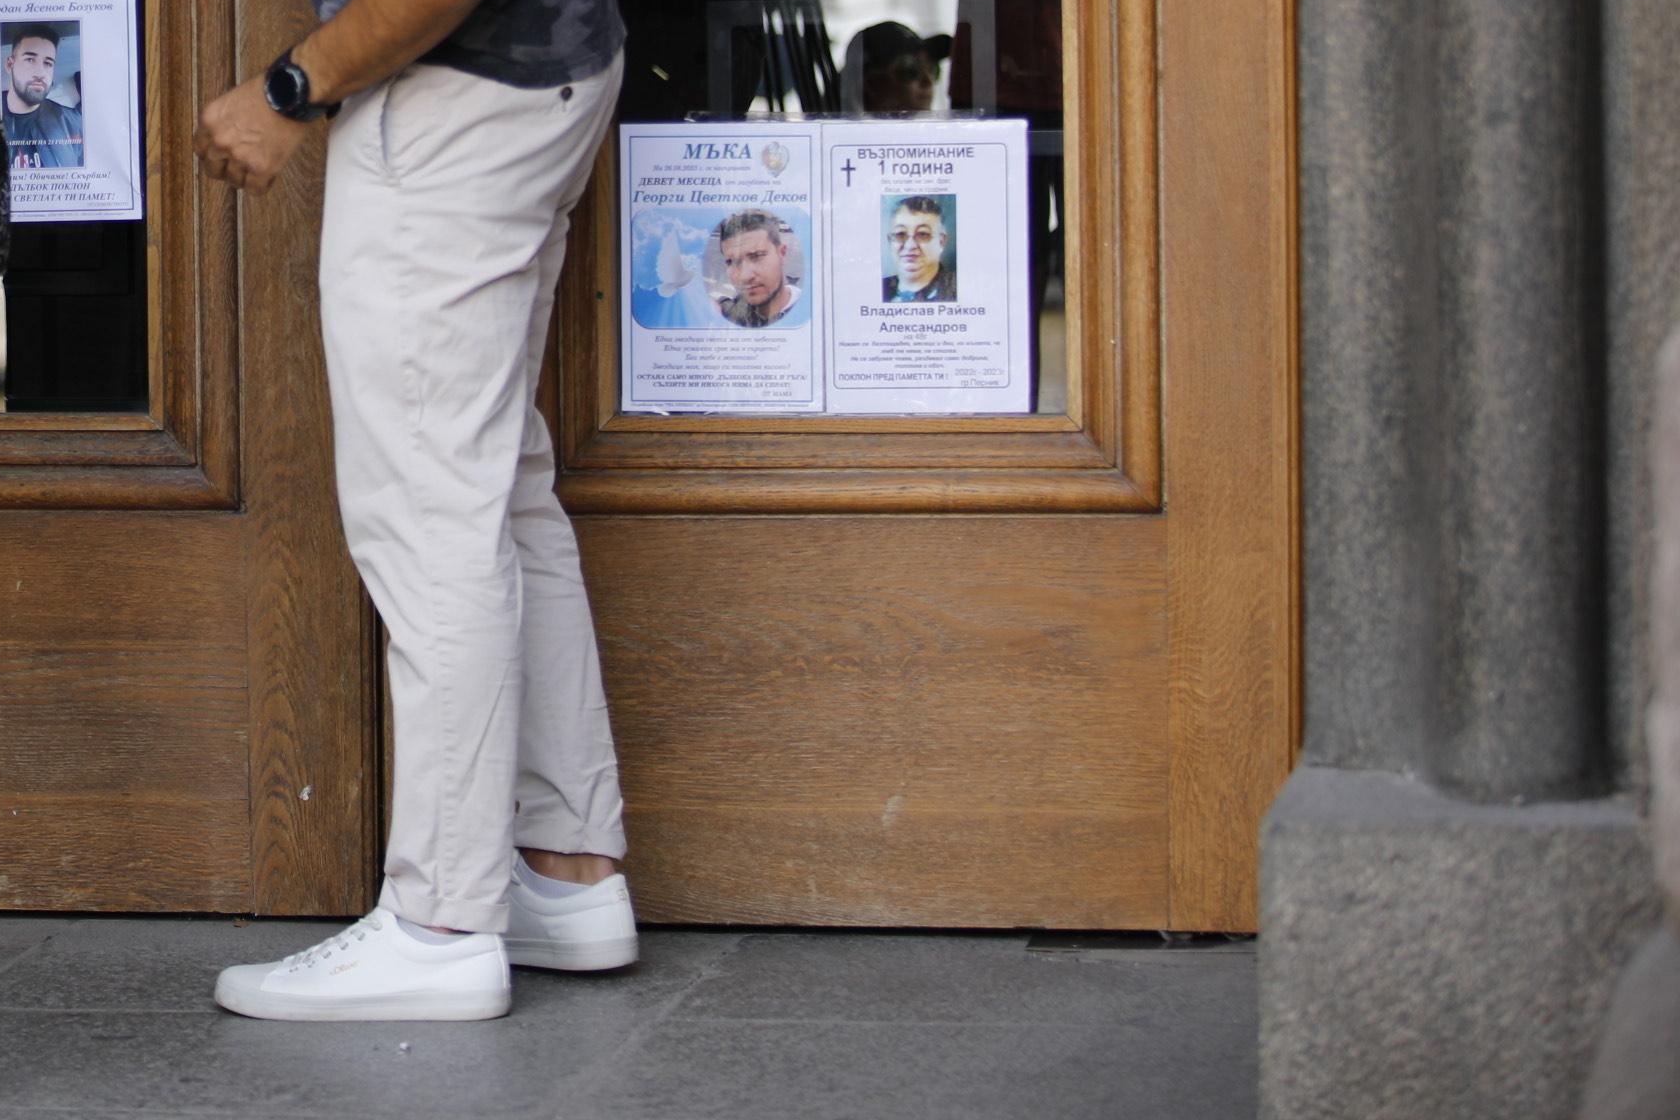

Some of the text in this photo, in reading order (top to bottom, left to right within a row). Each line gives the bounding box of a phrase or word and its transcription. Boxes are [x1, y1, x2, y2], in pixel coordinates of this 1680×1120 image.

[24, 2, 65, 14] Ясенов
[68, 1, 114, 13] Бозуков
[682, 143, 753, 160] МЪКА
[857, 146, 975, 160] ВЪЗПОМИНАНИЕ
[878, 160, 954, 177] 1 година
[29, 171, 70, 181] Обичаме!
[71, 170, 112, 181] Скърбим!
[50, 182, 91, 192] ПОКЛОН
[638, 177, 675, 188] ДЕВЕТ
[676, 177, 722, 187] МЕСЕЦА
[14, 192, 117, 204] СВЕТЛАТА ТИ ПАМЕТ!
[633, 190, 808, 206] Георги Цветков Деков
[860, 304, 986, 319] Владислав Райков
[878, 321, 968, 336] Александров
[838, 372, 872, 381] ПОКЛОН
[872, 372, 895, 382] ПРЕД
[895, 372, 934, 381] ПАМЕТТА
[934, 372, 945, 381] ТИ
